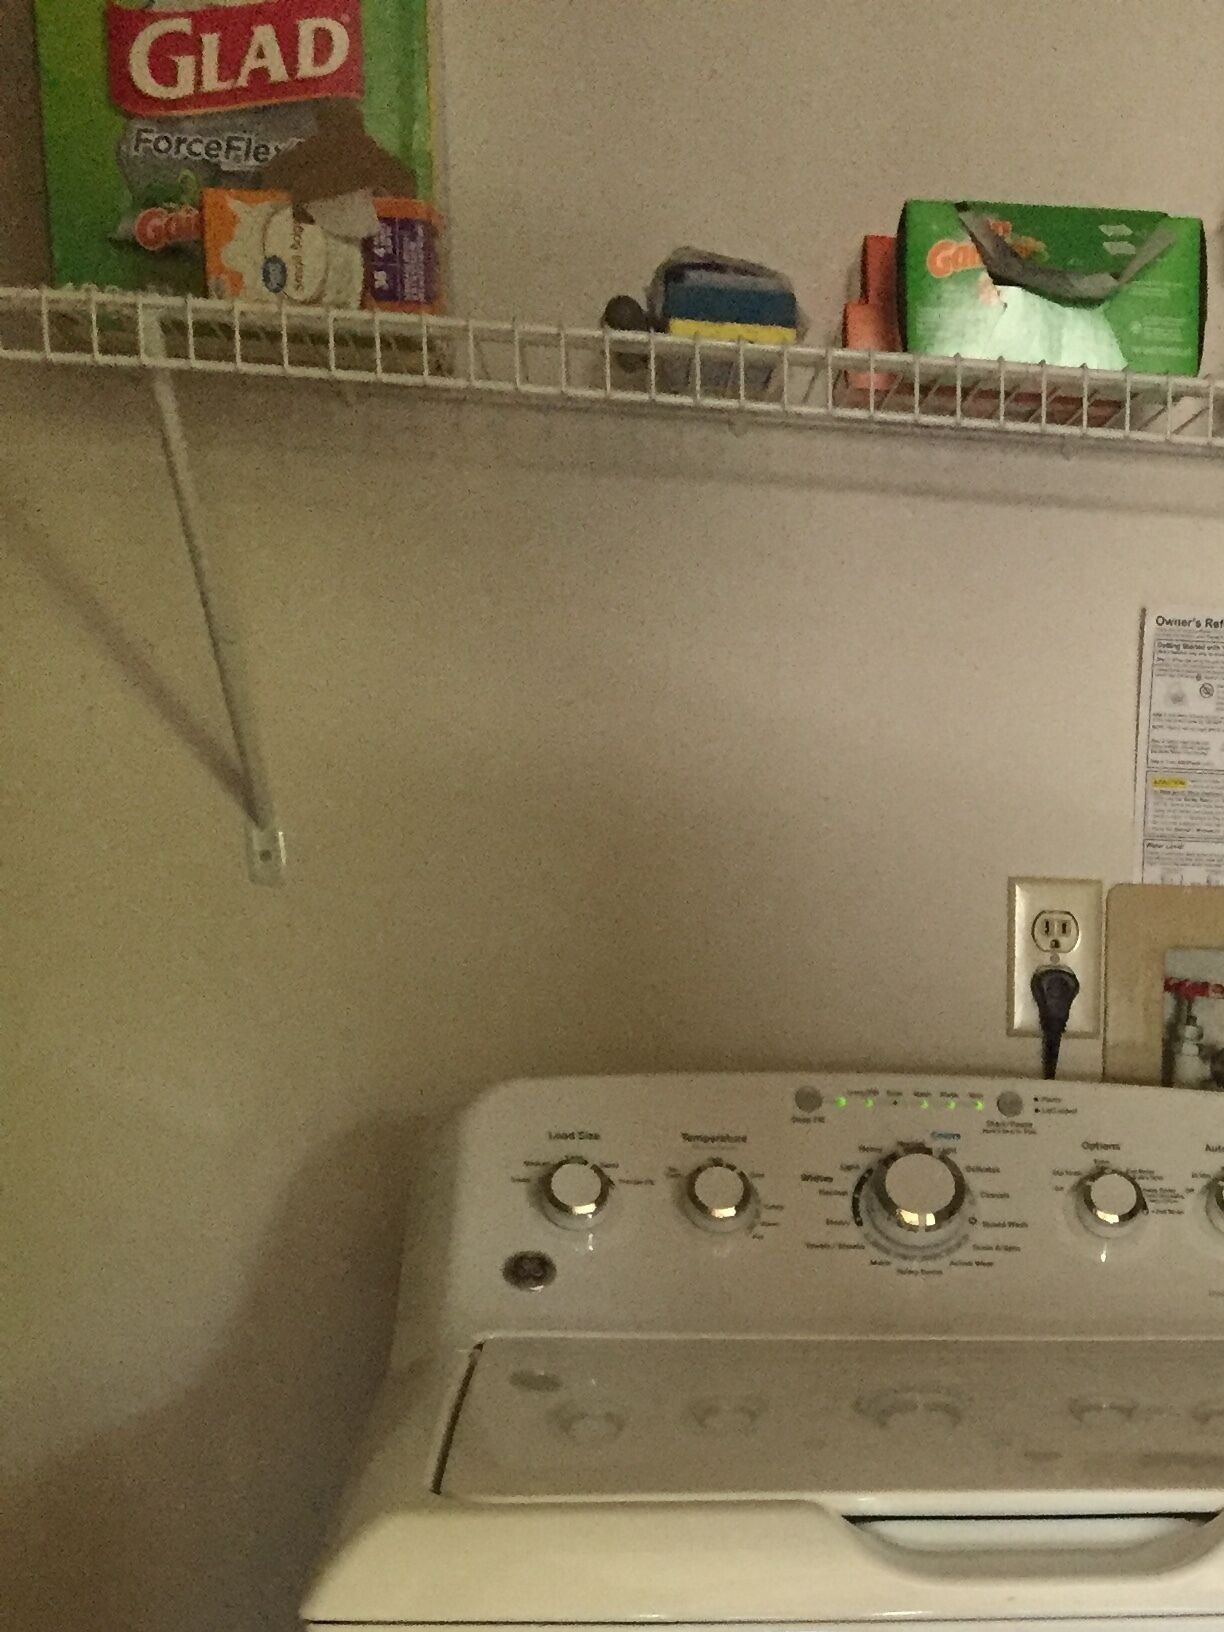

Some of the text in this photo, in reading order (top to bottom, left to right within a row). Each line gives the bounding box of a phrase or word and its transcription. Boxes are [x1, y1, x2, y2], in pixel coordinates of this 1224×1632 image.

[129, 18, 350, 99] GLAD
[1155, 615, 1202, 630] Owner's
[548, 1131, 576, 1141] Load
[681, 1132, 748, 1144] Temperature
[1081, 1141, 1121, 1152] Options
